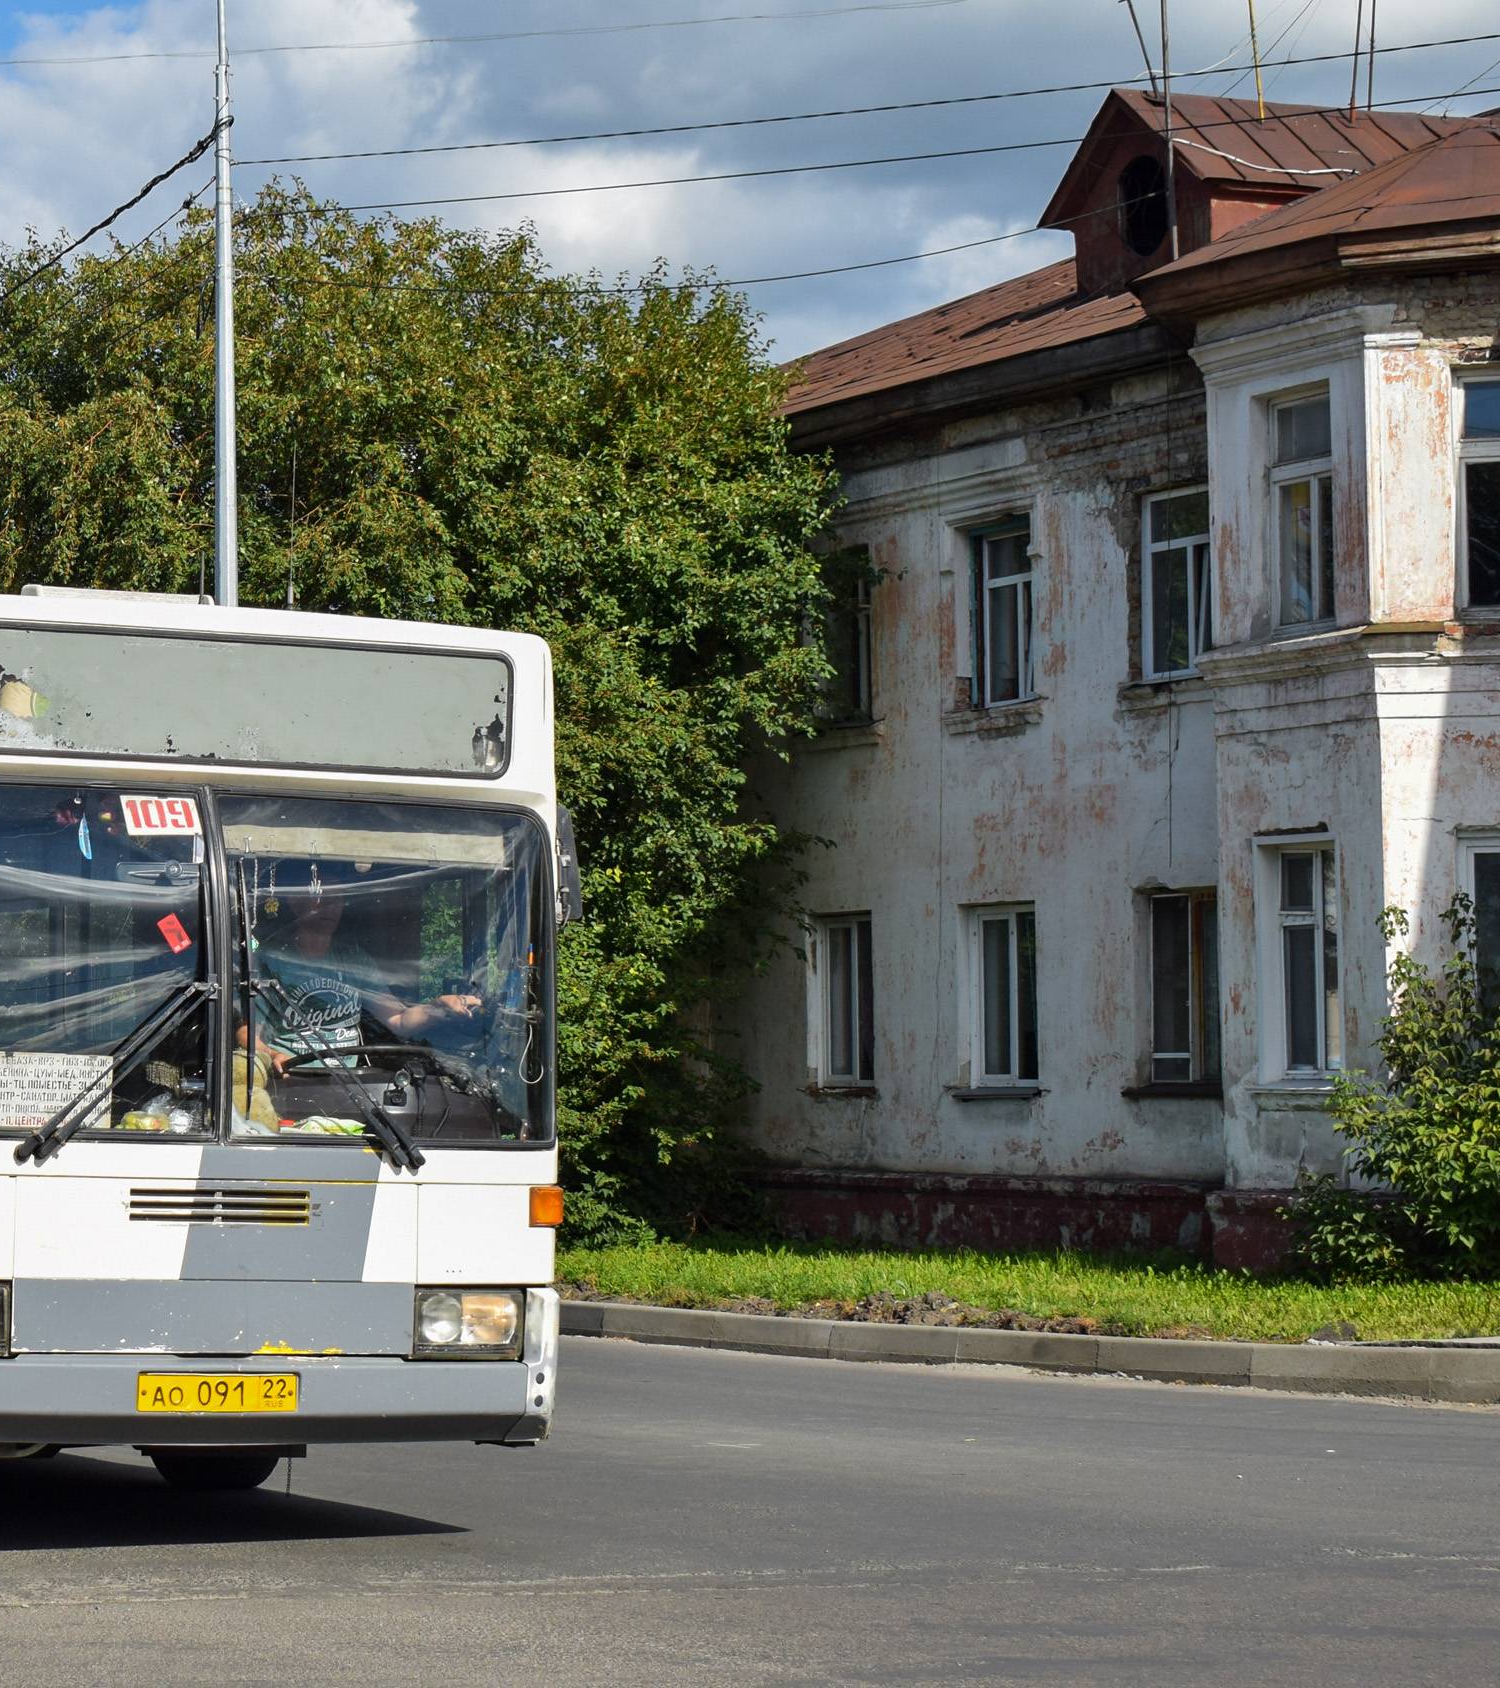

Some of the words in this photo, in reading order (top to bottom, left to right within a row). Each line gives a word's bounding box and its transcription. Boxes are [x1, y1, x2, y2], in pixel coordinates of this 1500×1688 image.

[126, 800, 195, 828] 109
[283, 991, 361, 1029] Original
[197, 1380, 245, 1406] 091
[263, 1378, 287, 1399] 22
[264, 1400, 284, 1408] RUS
